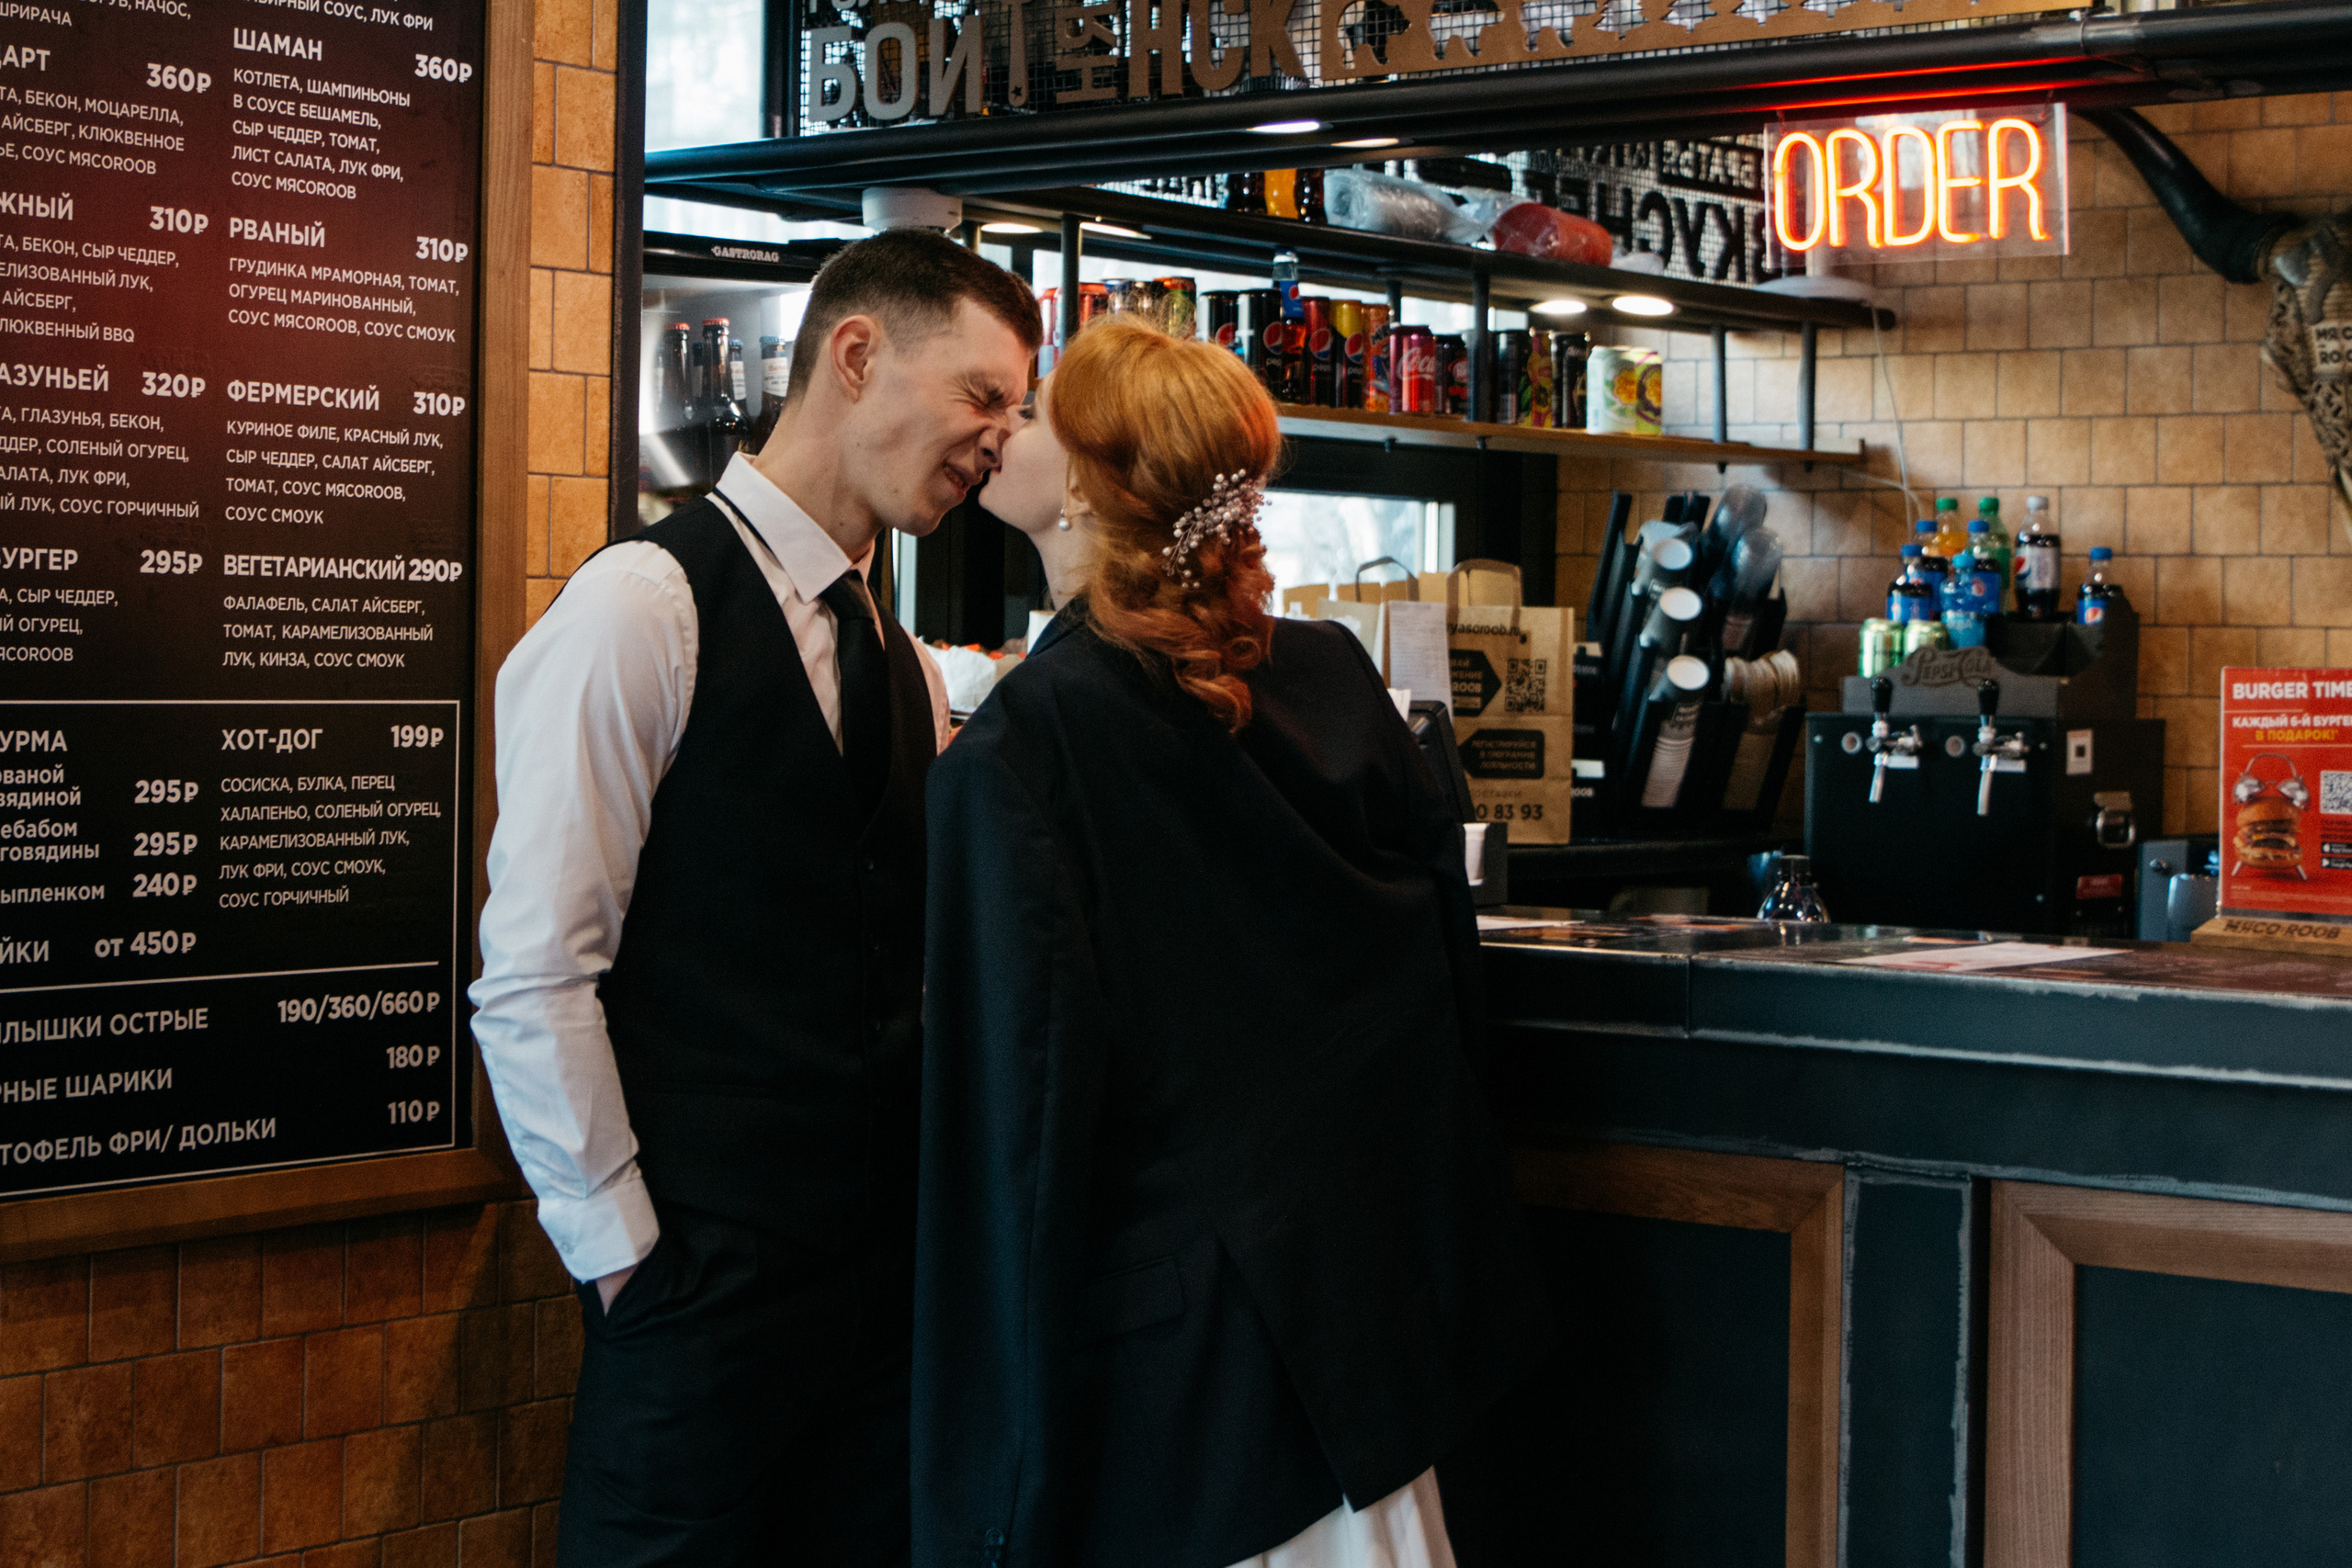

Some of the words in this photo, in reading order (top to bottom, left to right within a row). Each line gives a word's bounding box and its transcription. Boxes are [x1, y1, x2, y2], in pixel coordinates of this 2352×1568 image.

[0, 1, 73, 27] ШРИРАЧА
[135, 0, 191, 20] НАЧОС,
[323, 0, 368, 23] СОУС,
[369, 7, 400, 26] ЛУК
[402, 13, 433, 31] ФРИ
[233, 27, 322, 62] ШАМАН
[0, 44, 51, 72] АРТ
[233, 68, 303, 94] КОТЛЕТА,
[307, 78, 411, 107] ШАМПИНЬОНЫ
[25, 89, 82, 113] БЕКОН,
[85, 97, 184, 127] МОЦАРЕЛЛА,
[232, 93, 243, 108] В
[246, 96, 296, 116] СОУСЕ
[300, 103, 381, 130] БЕШАМЕЛЬ,
[1, 112, 76, 140] АЙСБЕРГ,
[78, 124, 185, 152] КЛЮКВЕННОЕ
[232, 119, 264, 136] СЫР
[267, 124, 325, 148] ЧЕДДЕР,
[328, 132, 380, 155] ТОМАТ,
[21, 144, 65, 164] СОУС
[231, 145, 271, 164] ЛИСТ
[274, 151, 335, 175] САЛАТА,
[338, 159, 368, 176] ЛУК
[370, 163, 403, 183] ФРИ,
[231, 171, 272, 189] СОУС
[1773, 118, 2050, 252] ORDER
[230, 217, 325, 248] РВАНЫЙ
[22, 236, 79, 258] БЕКОН,
[82, 243, 115, 259] СЫР
[118, 246, 179, 268] ЧЕДДЕР,
[712, 244, 780, 264] GASTRORAG
[118, 276, 153, 293] ЛУК,
[229, 257, 307, 279] ГРУДИНКА
[311, 265, 405, 291] МРАМОРНАЯ,
[408, 276, 459, 297] ТОМАТ,
[2, 288, 76, 313] АЙСБЕРГ,
[228, 283, 288, 305] ОГУРЕЦ
[290, 288, 416, 317] МАРИНОВАННЫЙ,
[0, 317, 99, 340] ЛЮКВЕННЫЙ
[103, 326, 135, 343] BBQ
[228, 309, 270, 326] СОУС
[364, 321, 403, 338] СОУС
[406, 324, 456, 343] СМОУК
[0, 362, 108, 391] АЗУНЬЕЙ
[227, 379, 379, 411] ФЕРМЕРСКИЙ
[21, 407, 105, 429] ГЛАЗУНЬЯ,
[109, 412, 164, 433] БЕКОН,
[227, 420, 293, 438] КУРИНОЕ
[297, 424, 340, 443] ФИЛЕ,
[344, 427, 410, 445] КРАСНЫЙ
[413, 432, 444, 449] ЛУК,
[46, 438, 123, 457] СОЛЕНЫЙ
[127, 443, 189, 463] ОГУРЕЦ,
[226, 448, 257, 464] СЫР
[261, 450, 318, 469] ЧЕДДЕР,
[322, 454, 368, 470] САЛАТ
[372, 455, 435, 477] АЙСБЕРГ,
[0, 466, 53, 485] АЛАТА,
[57, 468, 89, 484] ЛУК
[93, 470, 130, 489] ФРИ,
[225, 477, 278, 496] ТОМАТ,
[282, 479, 322, 496] СОУС
[18, 496, 55, 514] ЛУК,
[60, 498, 103, 514] СОУС
[107, 500, 199, 518] ГОРЧИЧНЫЙ
[225, 505, 267, 522] СОУС
[271, 508, 323, 525] СМОУК
[0, 547, 78, 570] УРГЕР
[223, 554, 405, 581] ВЕГЕТАРИАНСКИЙ
[17, 588, 51, 603] СЫР
[55, 589, 119, 607] ЧЕДДЕР,
[223, 595, 308, 614] ФАЛАФЕЛЬ,
[311, 597, 359, 612] САЛАТ
[361, 596, 425, 616] АЙСБЕРГ,
[18, 617, 83, 635] ОГУРЕЦ,
[222, 624, 276, 641] ТОМАТ,
[282, 624, 433, 641] КАРАМЕЛИЗОВАННЫЙ
[221, 651, 255, 669] ЛУК,
[259, 651, 310, 669] КИНЗА,
[313, 652, 353, 667] СОУС
[356, 652, 405, 668] СМОУК
[2232, 682, 2309, 701] BURGER
[2231, 713, 2289, 729] КАЖДЫЙ
[2312, 714, 2352, 728] БУРГЕ
[0, 729, 68, 752] УРМА
[220, 728, 323, 753] ХОТ-ДОГ
[220, 776, 293, 794] СОСИСКА,
[297, 775, 347, 793] БУЛКА,
[351, 774, 395, 792] ПЕРЕЦ
[220, 805, 311, 821] ХАЛАПЕНЬО,
[314, 799, 383, 819] СОЛЕНЫЙ
[1493, 803, 1515, 820] 83
[1520, 803, 1544, 821] 93
[0, 818, 77, 839] ебабом
[220, 828, 375, 851] КАРАМЕЛИЗОВАННЫЙ
[379, 830, 410, 846] ЛУК,
[0, 843, 99, 863] говядины
[219, 863, 249, 879] ЛУК
[253, 863, 287, 879] ФРИ,
[290, 861, 330, 876] СОУС
[334, 859, 386, 875] СМОУК,
[0, 885, 105, 904] ыпленком
[219, 892, 259, 908] СОУС
[264, 885, 349, 907] ГОРЧИЧНЫЙ
[0, 936, 49, 964] ЙКИ
[95, 938, 124, 958] от
[0, 1015, 102, 1044] ЛЫШКИ
[109, 1007, 209, 1035] ОСТРЫЕ
[0, 1077, 57, 1103] НЫЕ
[65, 1067, 172, 1098] ШАРИКИ
[0, 1135, 102, 1166] ТОФЕЛЬ
[178, 1117, 276, 1151] ДОЛЬКИ
